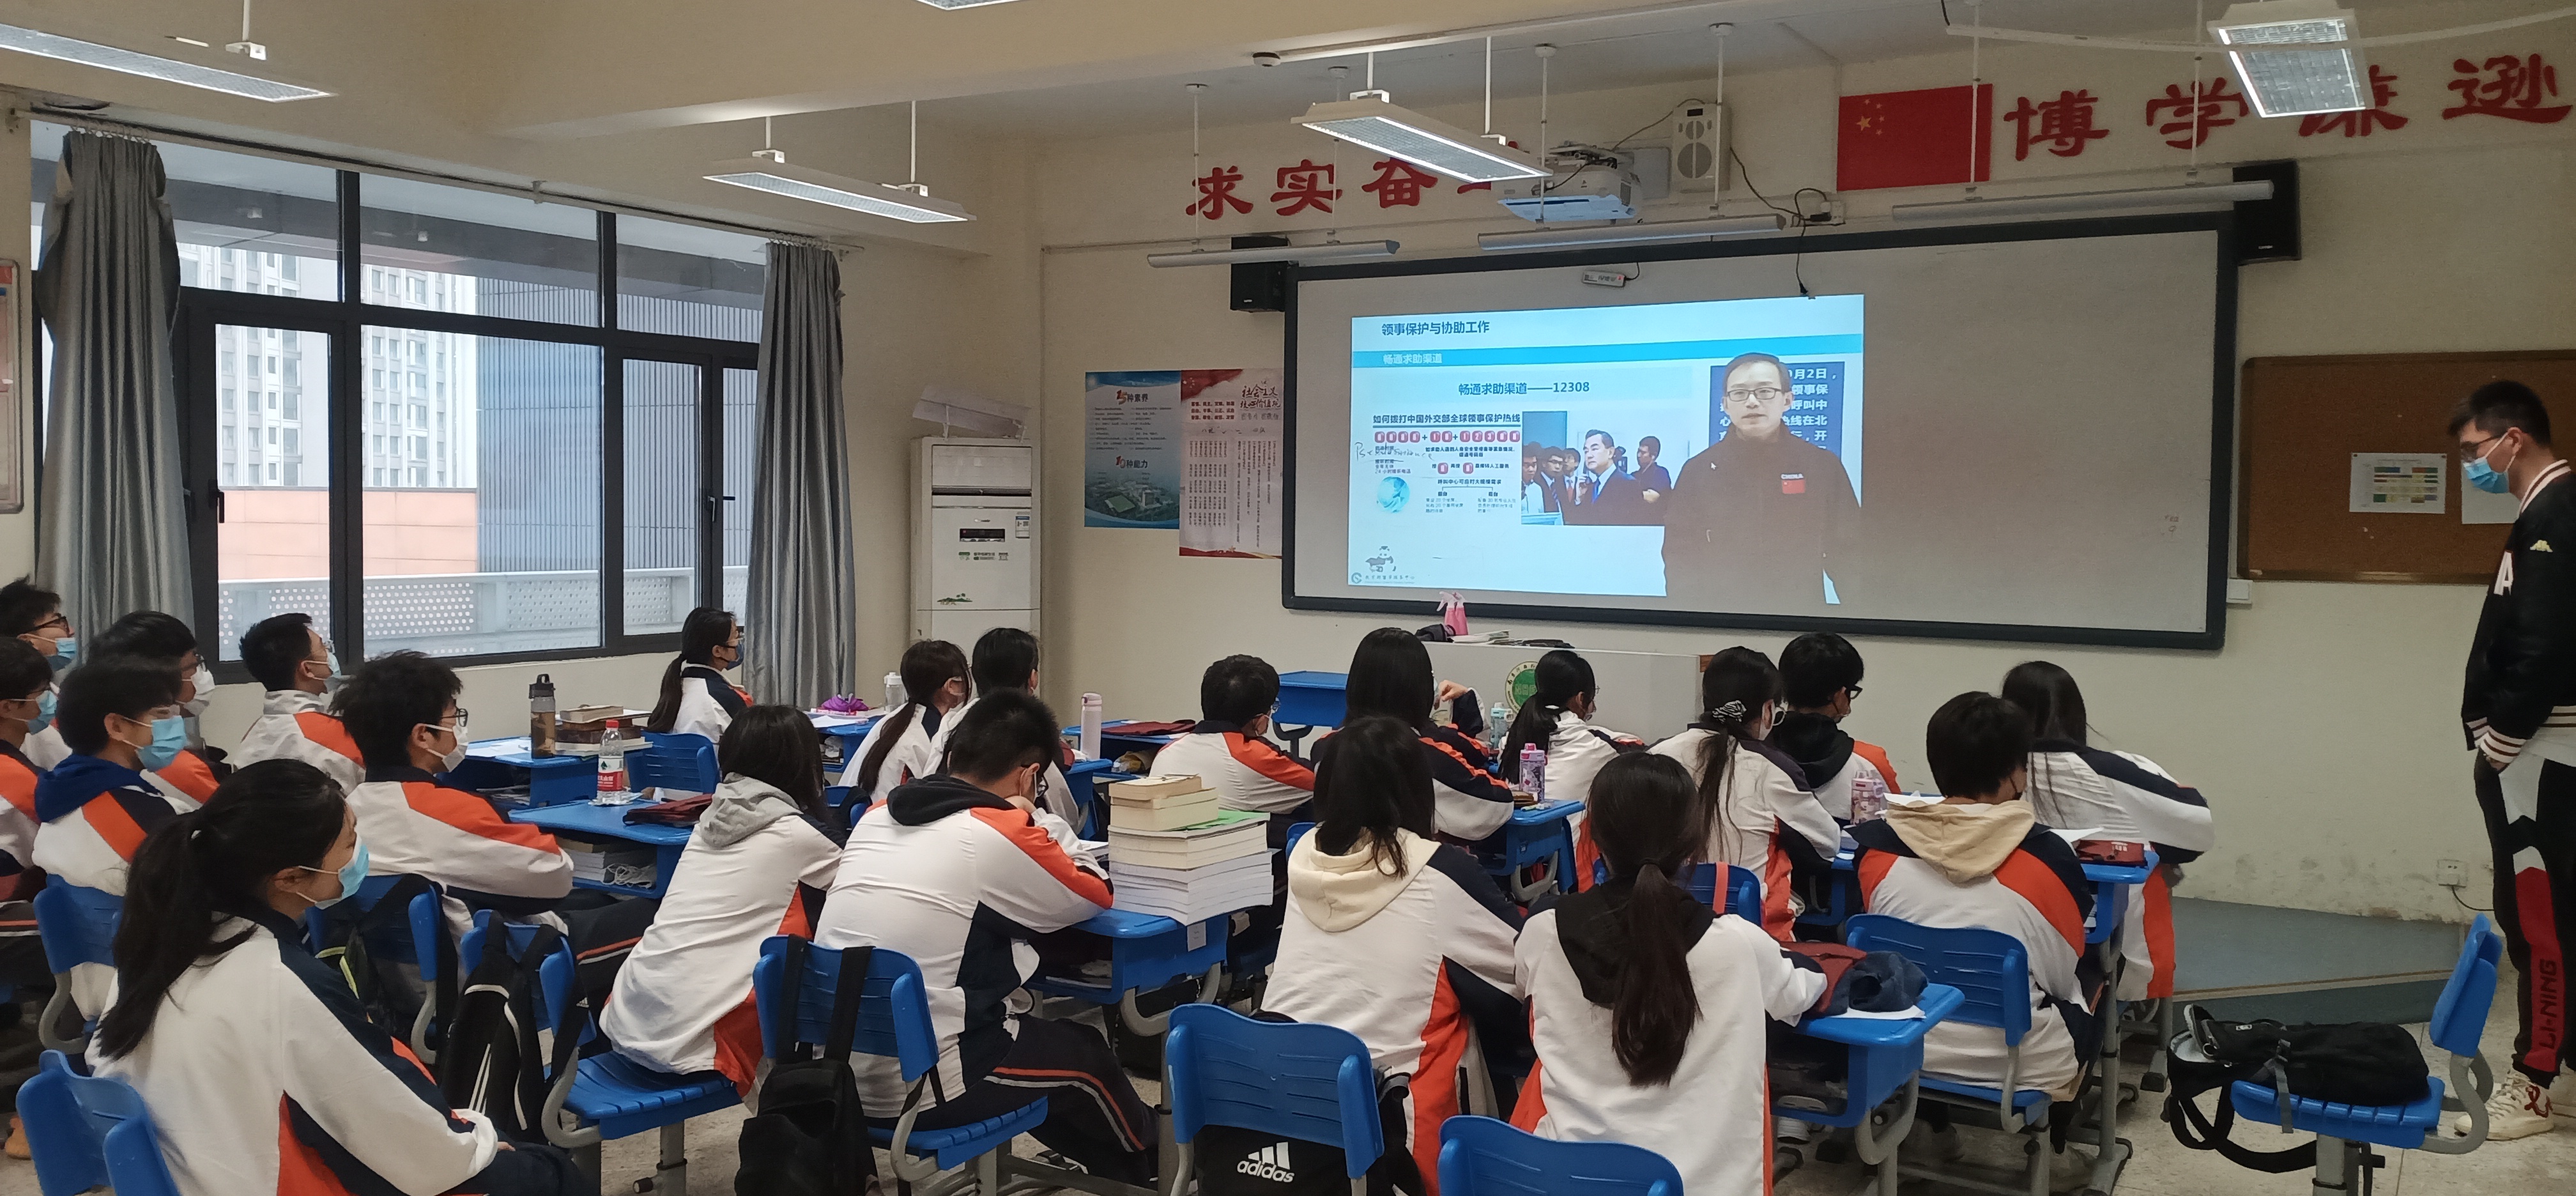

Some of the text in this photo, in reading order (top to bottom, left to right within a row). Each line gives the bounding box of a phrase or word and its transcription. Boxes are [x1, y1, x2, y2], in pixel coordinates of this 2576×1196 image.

[1186, 158, 1492, 220] 求实奋
[1381, 321, 1490, 335] 领事保护与协助工作
[1383, 353, 1443, 365] 畅通求助渠道
[1792, 384, 1828, 395] 领事保
[1373, 413, 1521, 424] 如何拨打中国外交部全球领事保护热线
[2539, 958, 2557, 1050] LI-NING
[1237, 1160, 1295, 1183] adidas
